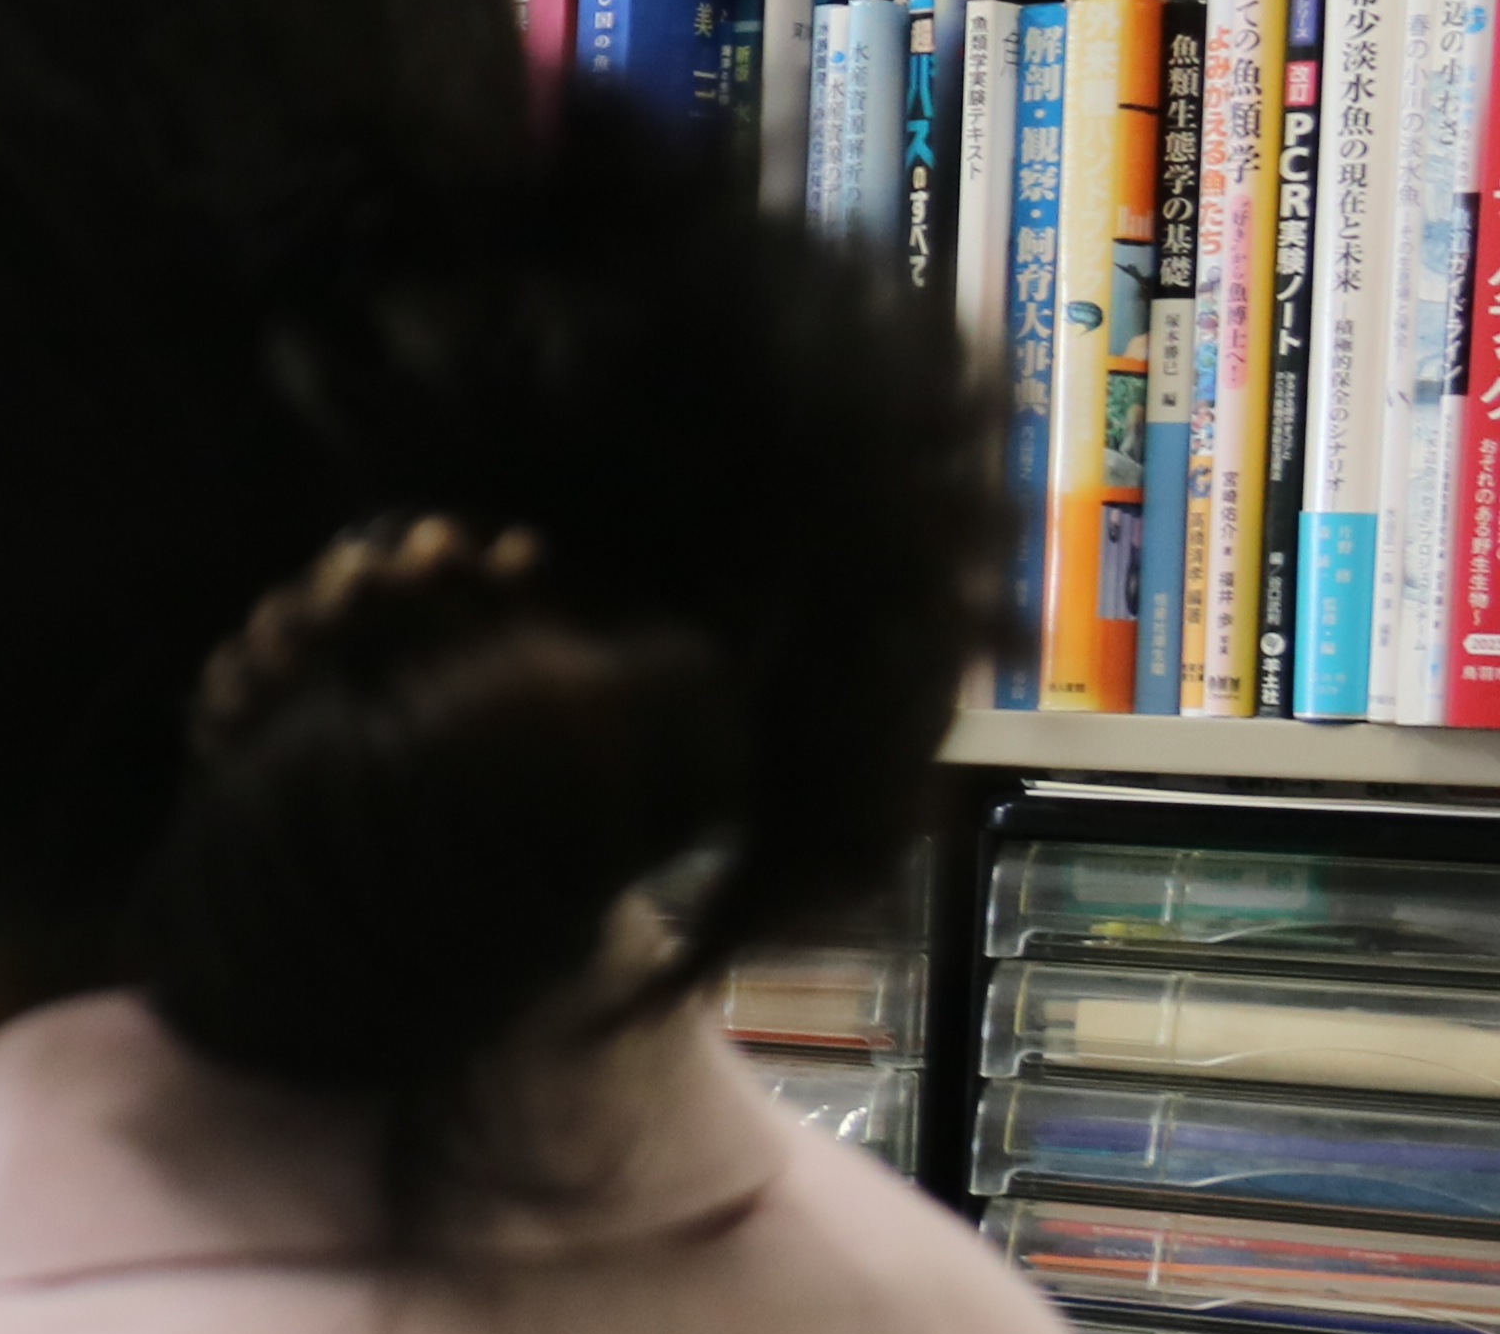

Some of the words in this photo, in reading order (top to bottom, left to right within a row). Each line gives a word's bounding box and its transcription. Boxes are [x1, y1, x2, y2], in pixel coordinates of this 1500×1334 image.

[965, 15, 989, 182] 魚類学実験テキスト
[1158, 33, 1201, 288] 魚類生態学の基礎
[1197, 24, 1234, 256] よみがえる魚たち
[1288, 64, 1311, 103] 改訂
[1398, 12, 1432, 209] 春の小川の淡水魚
[1014, 24, 1065, 417] 解剖・観察・飼育大事典
[1276, 111, 1315, 357] PCR実験ノート
[1260, 656, 1282, 706] 羊土社
